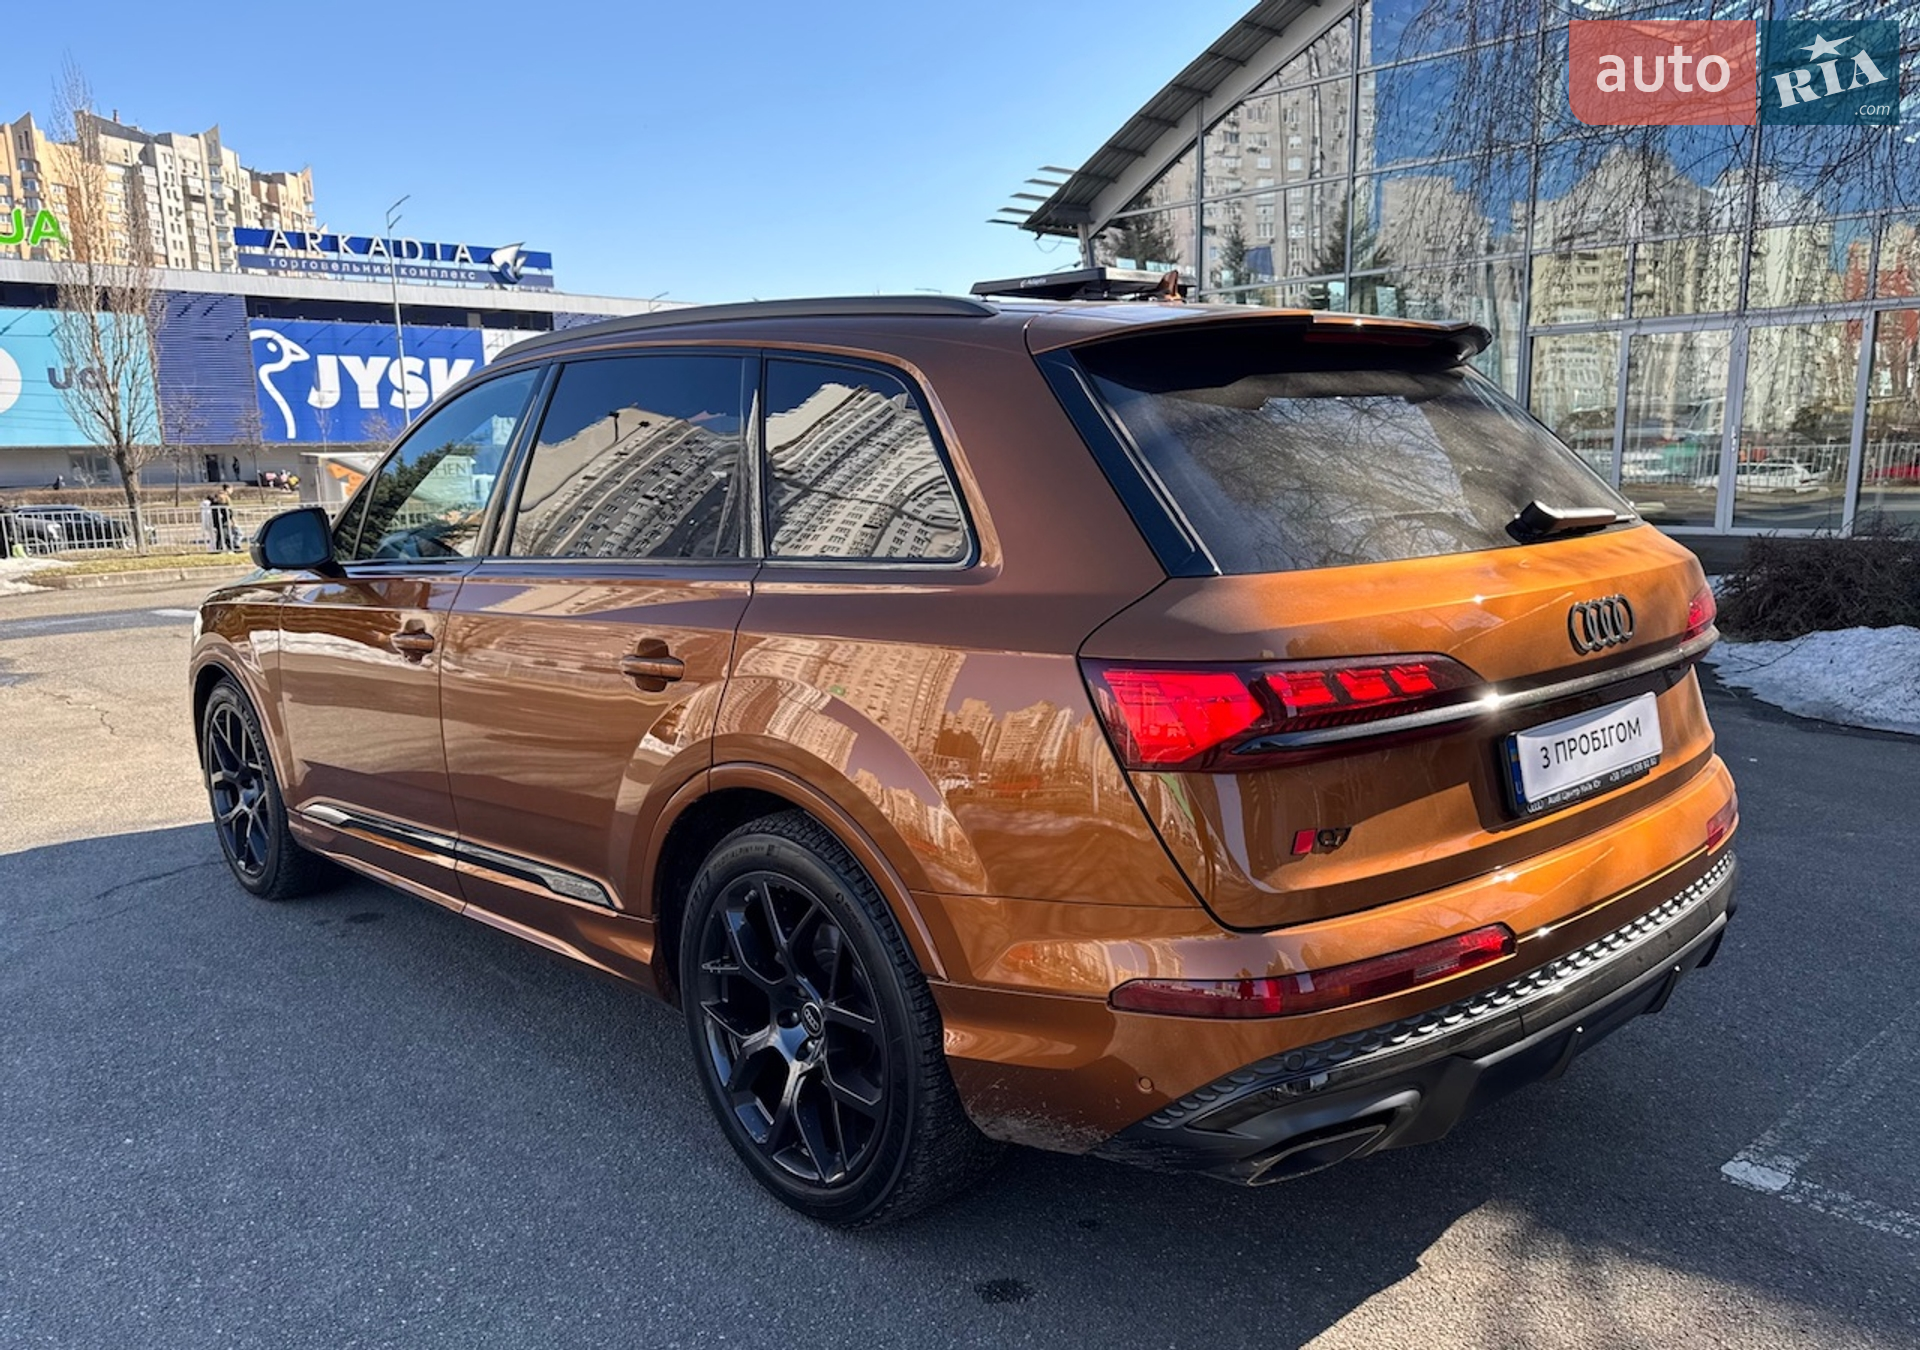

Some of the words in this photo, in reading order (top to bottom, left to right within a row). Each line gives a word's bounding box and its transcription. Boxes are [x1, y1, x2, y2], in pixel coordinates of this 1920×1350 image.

[268, 227, 474, 266] ARKADIA
[269, 257, 391, 275] торговельний
[400, 265, 476, 282] комплекс
[307, 354, 475, 409] JYSK
[1554, 716, 1642, 765] ПРОБІГОМ
